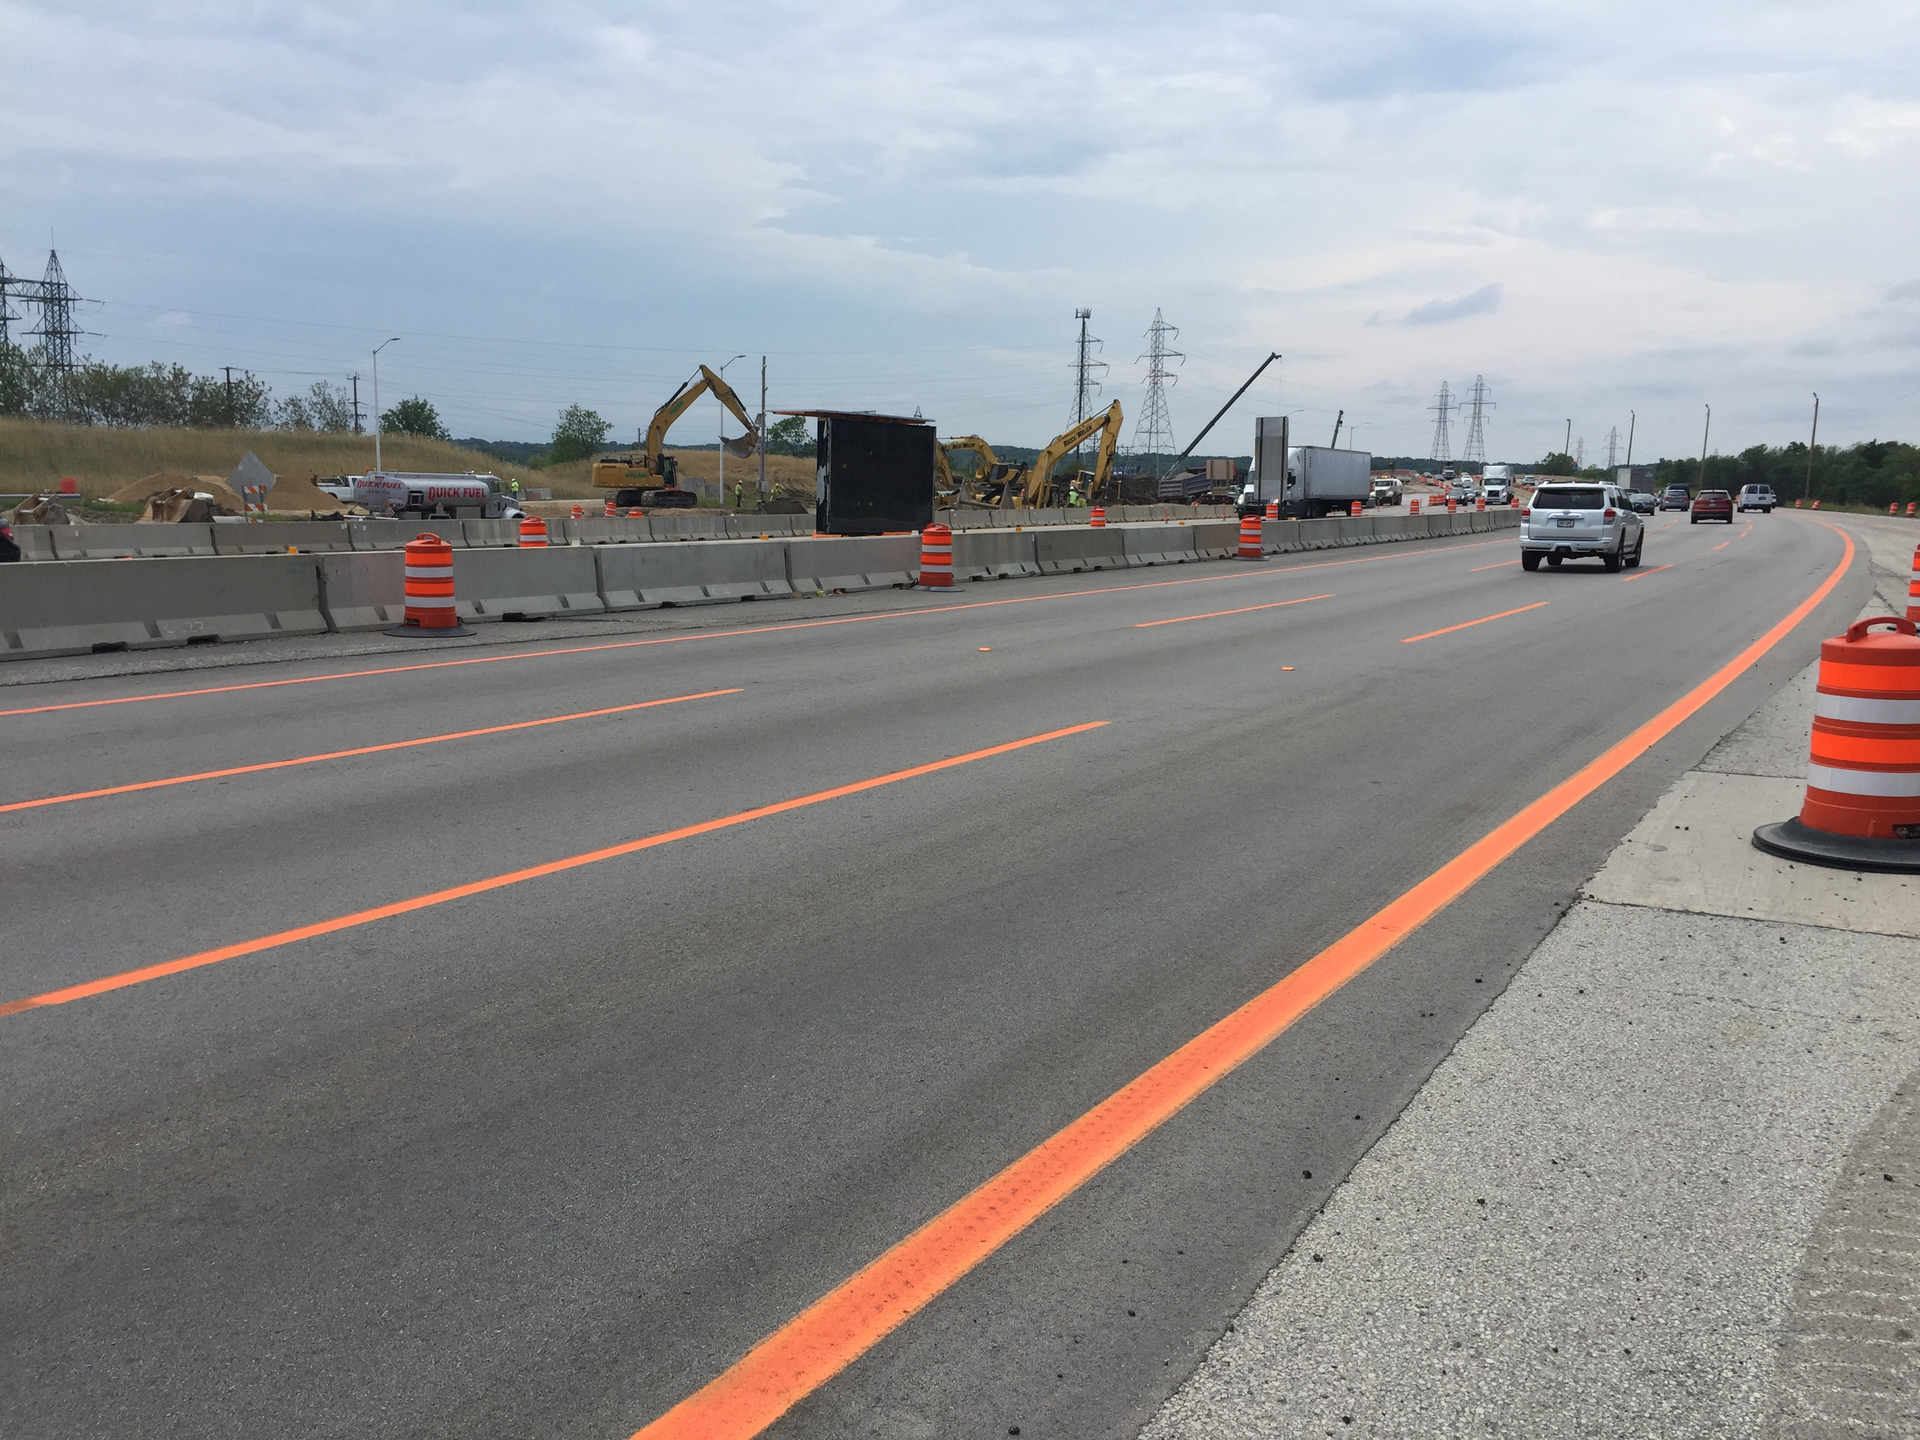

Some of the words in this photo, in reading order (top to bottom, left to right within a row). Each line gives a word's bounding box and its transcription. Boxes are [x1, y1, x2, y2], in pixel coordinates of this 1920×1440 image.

[357, 480, 380, 489] QUICK
[428, 486, 460, 501] QUICK
[463, 487, 487, 498] FUEL
